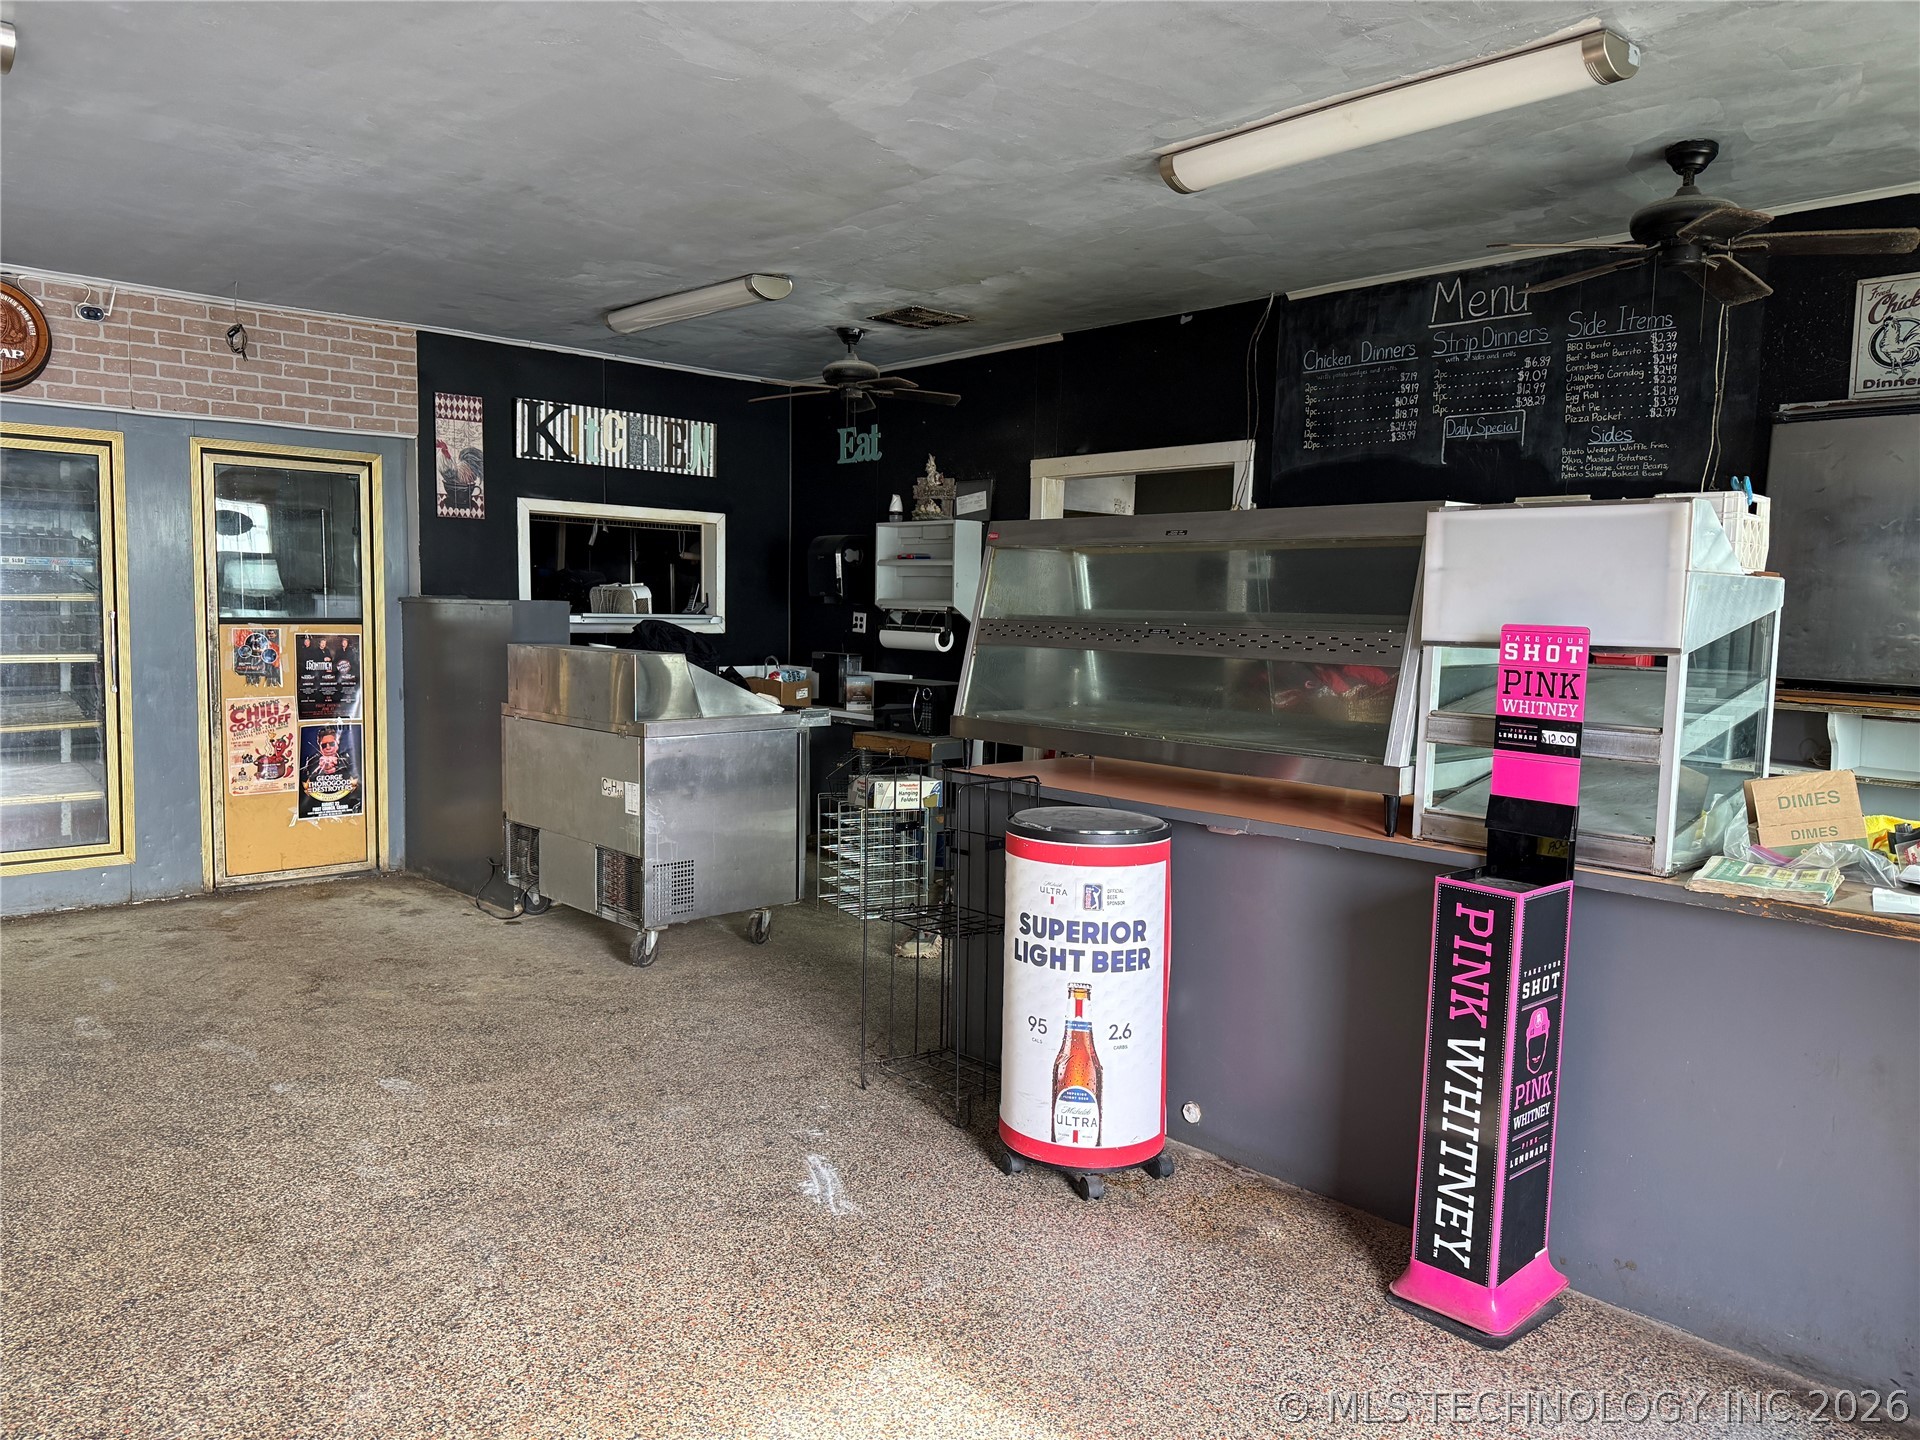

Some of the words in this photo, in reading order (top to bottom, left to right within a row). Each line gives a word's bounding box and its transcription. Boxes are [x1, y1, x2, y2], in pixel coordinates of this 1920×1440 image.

[1431, 277, 1530, 323] Menu
[1567, 311, 1607, 337] Side
[1616, 305, 1674, 332] Items
[1433, 330, 1478, 358] Strip
[1482, 326, 1549, 348] Dinners
[1567, 342, 1583, 352] BBQ
[1585, 339, 1612, 350] Burrito
[1303, 348, 1352, 370] Chicken
[1361, 340, 1417, 363] Dinners
[1612, 347, 1642, 357] Burrito
[1523, 355, 1552, 369] $6.89
[1565, 361, 1599, 372] Corndog
[1517, 368, 1548, 382] $9.09
[1606, 368, 1645, 380] Corndog
[1566, 383, 1595, 393] Crispito
[1515, 394, 1546, 409] $38.29
[1565, 393, 1580, 405] Egg
[1583, 391, 1600, 400] Roll
[1565, 404, 1586, 413] Meat
[1588, 402, 1601, 412] Pie
[1652, 394, 1680, 408] $3.59
[1564, 414, 1589, 424] Pizza
[1591, 411, 1623, 422] Pocket
[1446, 418, 1474, 441] Daily
[1476, 416, 1519, 440] Special
[1588, 425, 1634, 443] Sides
[836, 423, 883, 465] Eat
[1561, 447, 1585, 456] Potato
[1561, 464, 1578, 472] Mac
[1586, 454, 1615, 463] Mashed
[1611, 470, 1639, 478] Baked
[1505, 634, 1540, 643] TAKE
[1547, 636, 1584, 645] YOUR
[1504, 642, 1584, 664] SHOT
[1502, 669, 1581, 700] PINK
[1502, 698, 1579, 718] WHITNEY
[229, 713, 292, 733] COOK-OFF
[1498, 732, 1538, 741] LEMONADE
[308, 780, 351, 788] THOROGOOD
[1777, 790, 1841, 810] DIMES
[1790, 825, 1839, 840] DIMES
[1040, 886, 1068, 896] ULTRA
[1019, 912, 1147, 944] SUPERIOR
[1014, 937, 1086, 972] LIGHT
[1091, 947, 1151, 973] BEER
[1449, 902, 1494, 1029] PINK
[1523, 966, 1541, 978] TAKE
[1543, 959, 1561, 971] YOUR
[1522, 971, 1560, 1000] SHOT
[1027, 1015, 1048, 1035] 95
[1108, 1022, 1132, 1041] 2.6
[1513, 1070, 1553, 1111] PINK
[1056, 1113, 1098, 1128] ULTRA
[1513, 1101, 1551, 1131] WHITNEY
[1433, 1036, 1486, 1269] WHITNEY
[1521, 1136, 1538, 1150] PINK
[1509, 1142, 1549, 1169] LEMONADE
